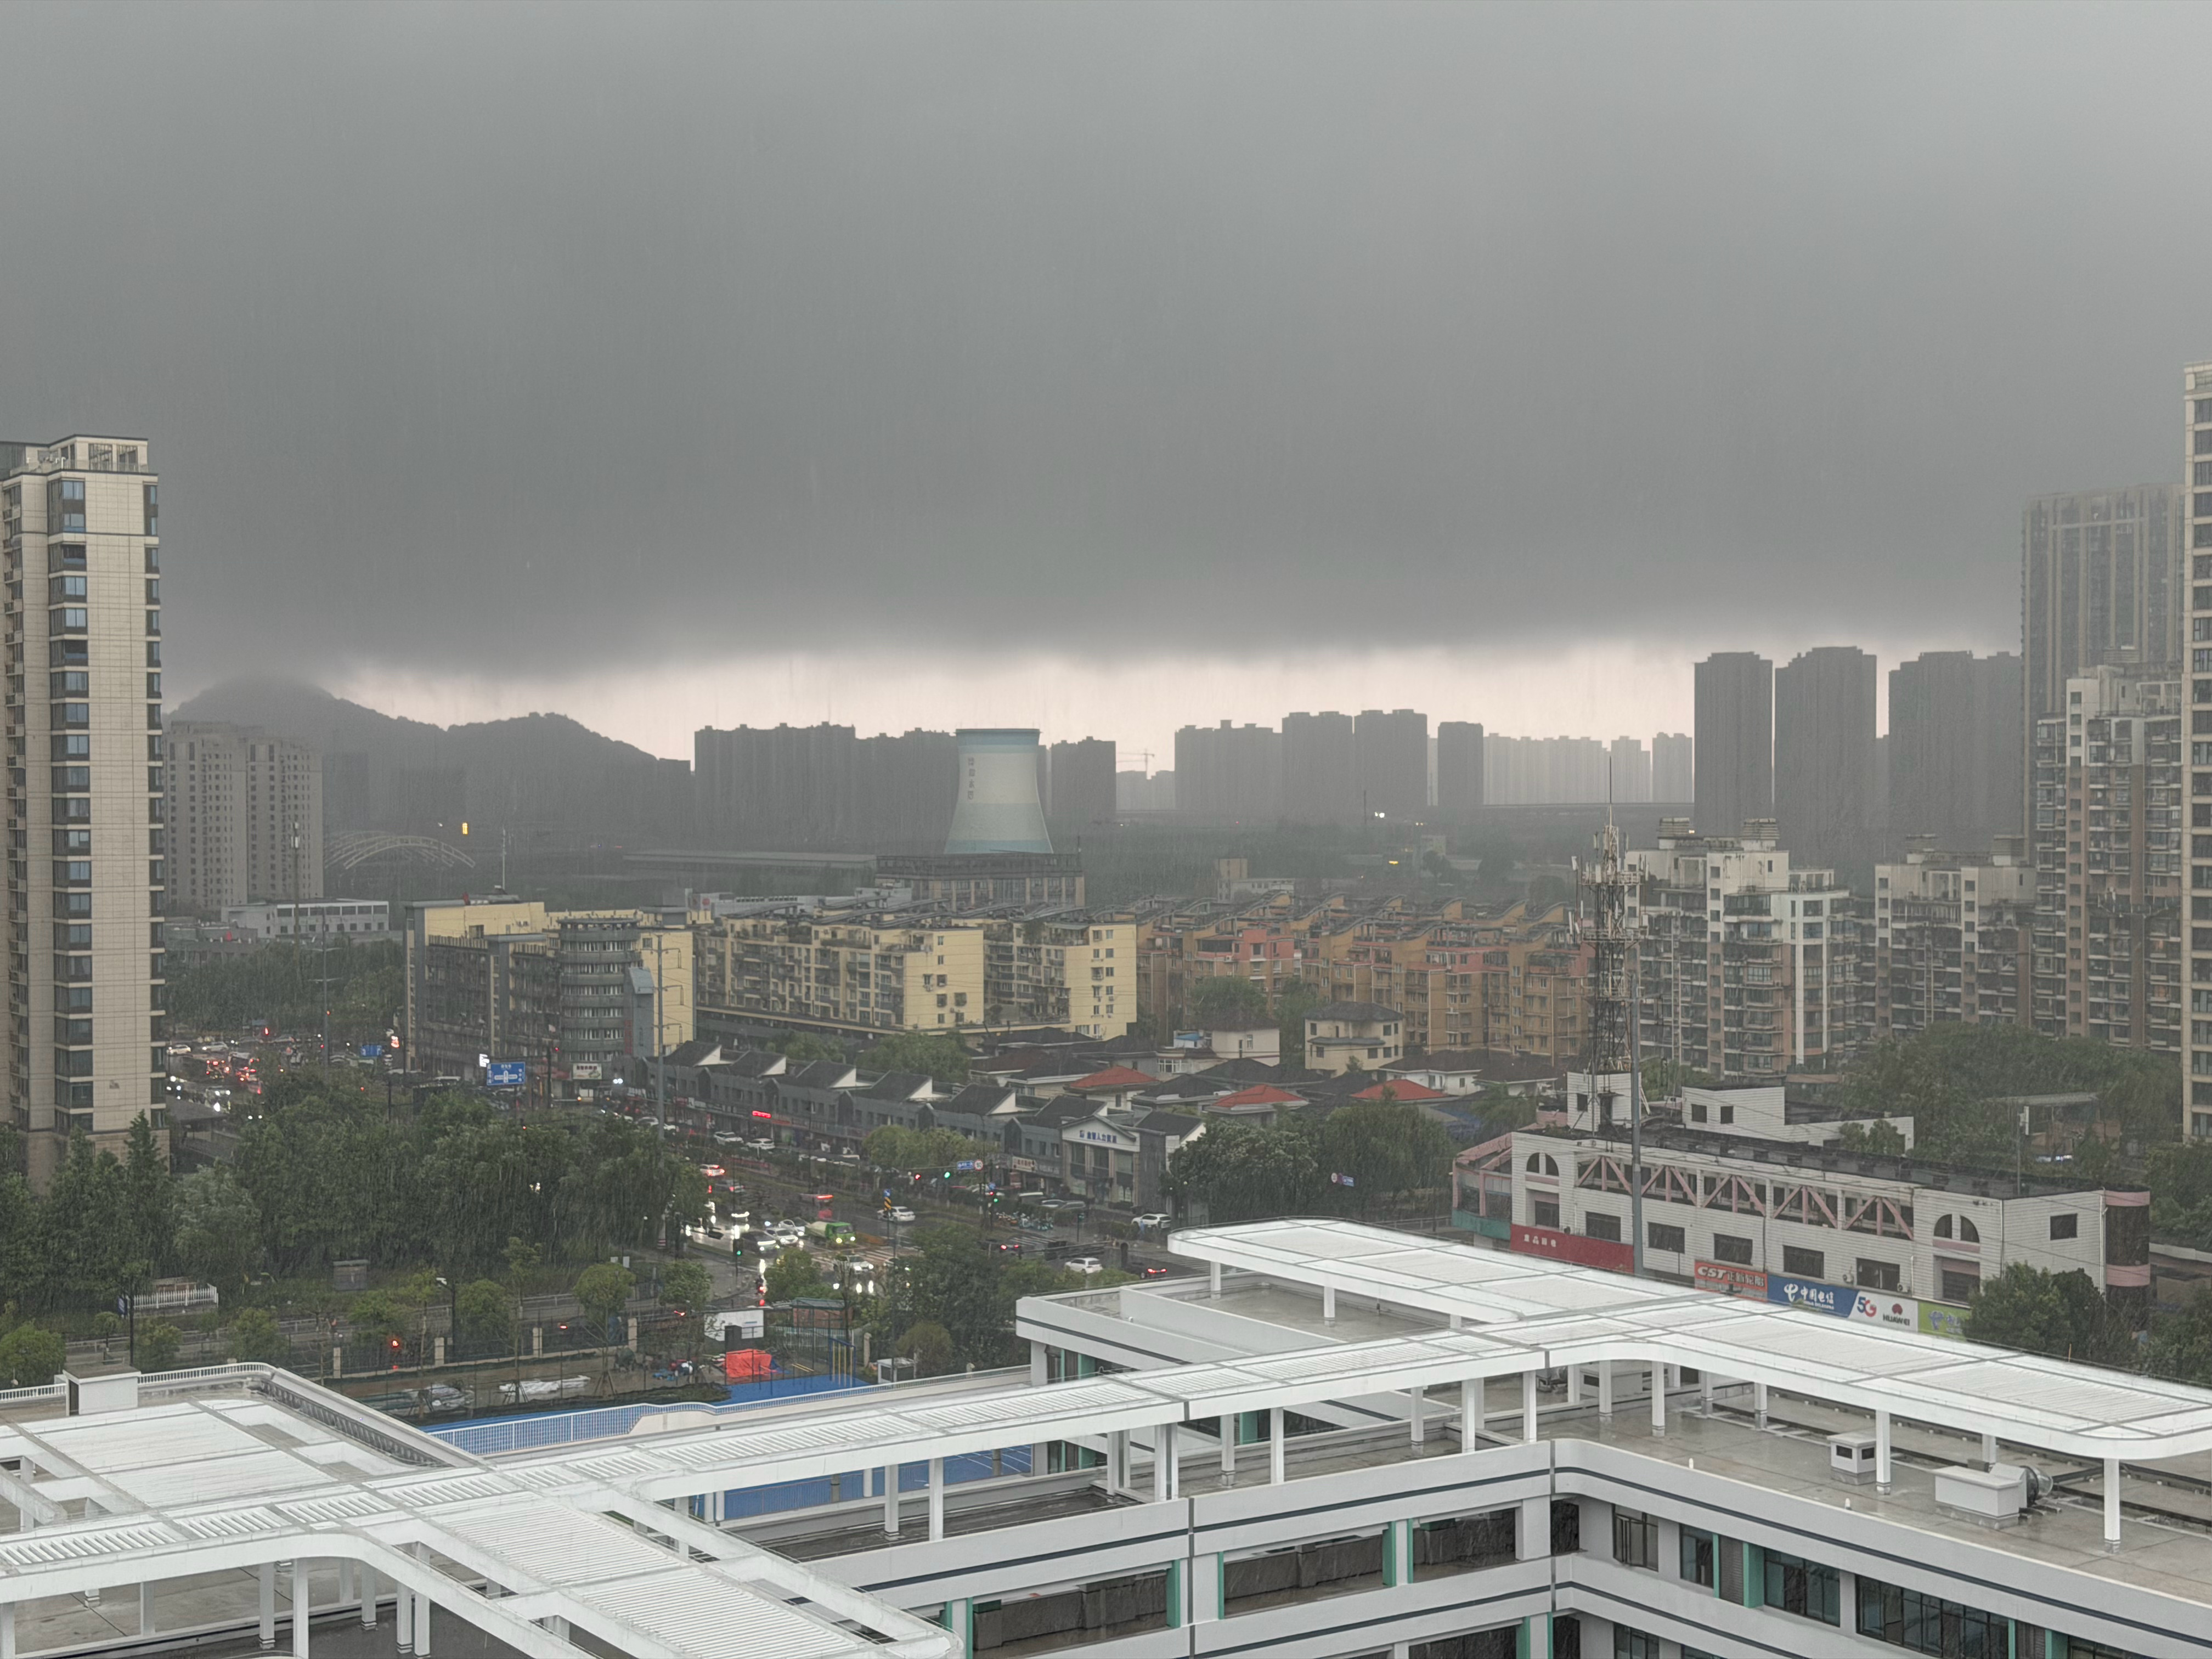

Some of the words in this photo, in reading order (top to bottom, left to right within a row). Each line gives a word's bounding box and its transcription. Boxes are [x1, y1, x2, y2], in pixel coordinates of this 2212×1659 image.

[1697, 1266, 1726, 1280] CST
[1800, 1286, 1834, 1304] 中国电信
[1857, 1296, 1877, 1317] 5G
[1882, 1313, 1910, 1326] HUAWEI
